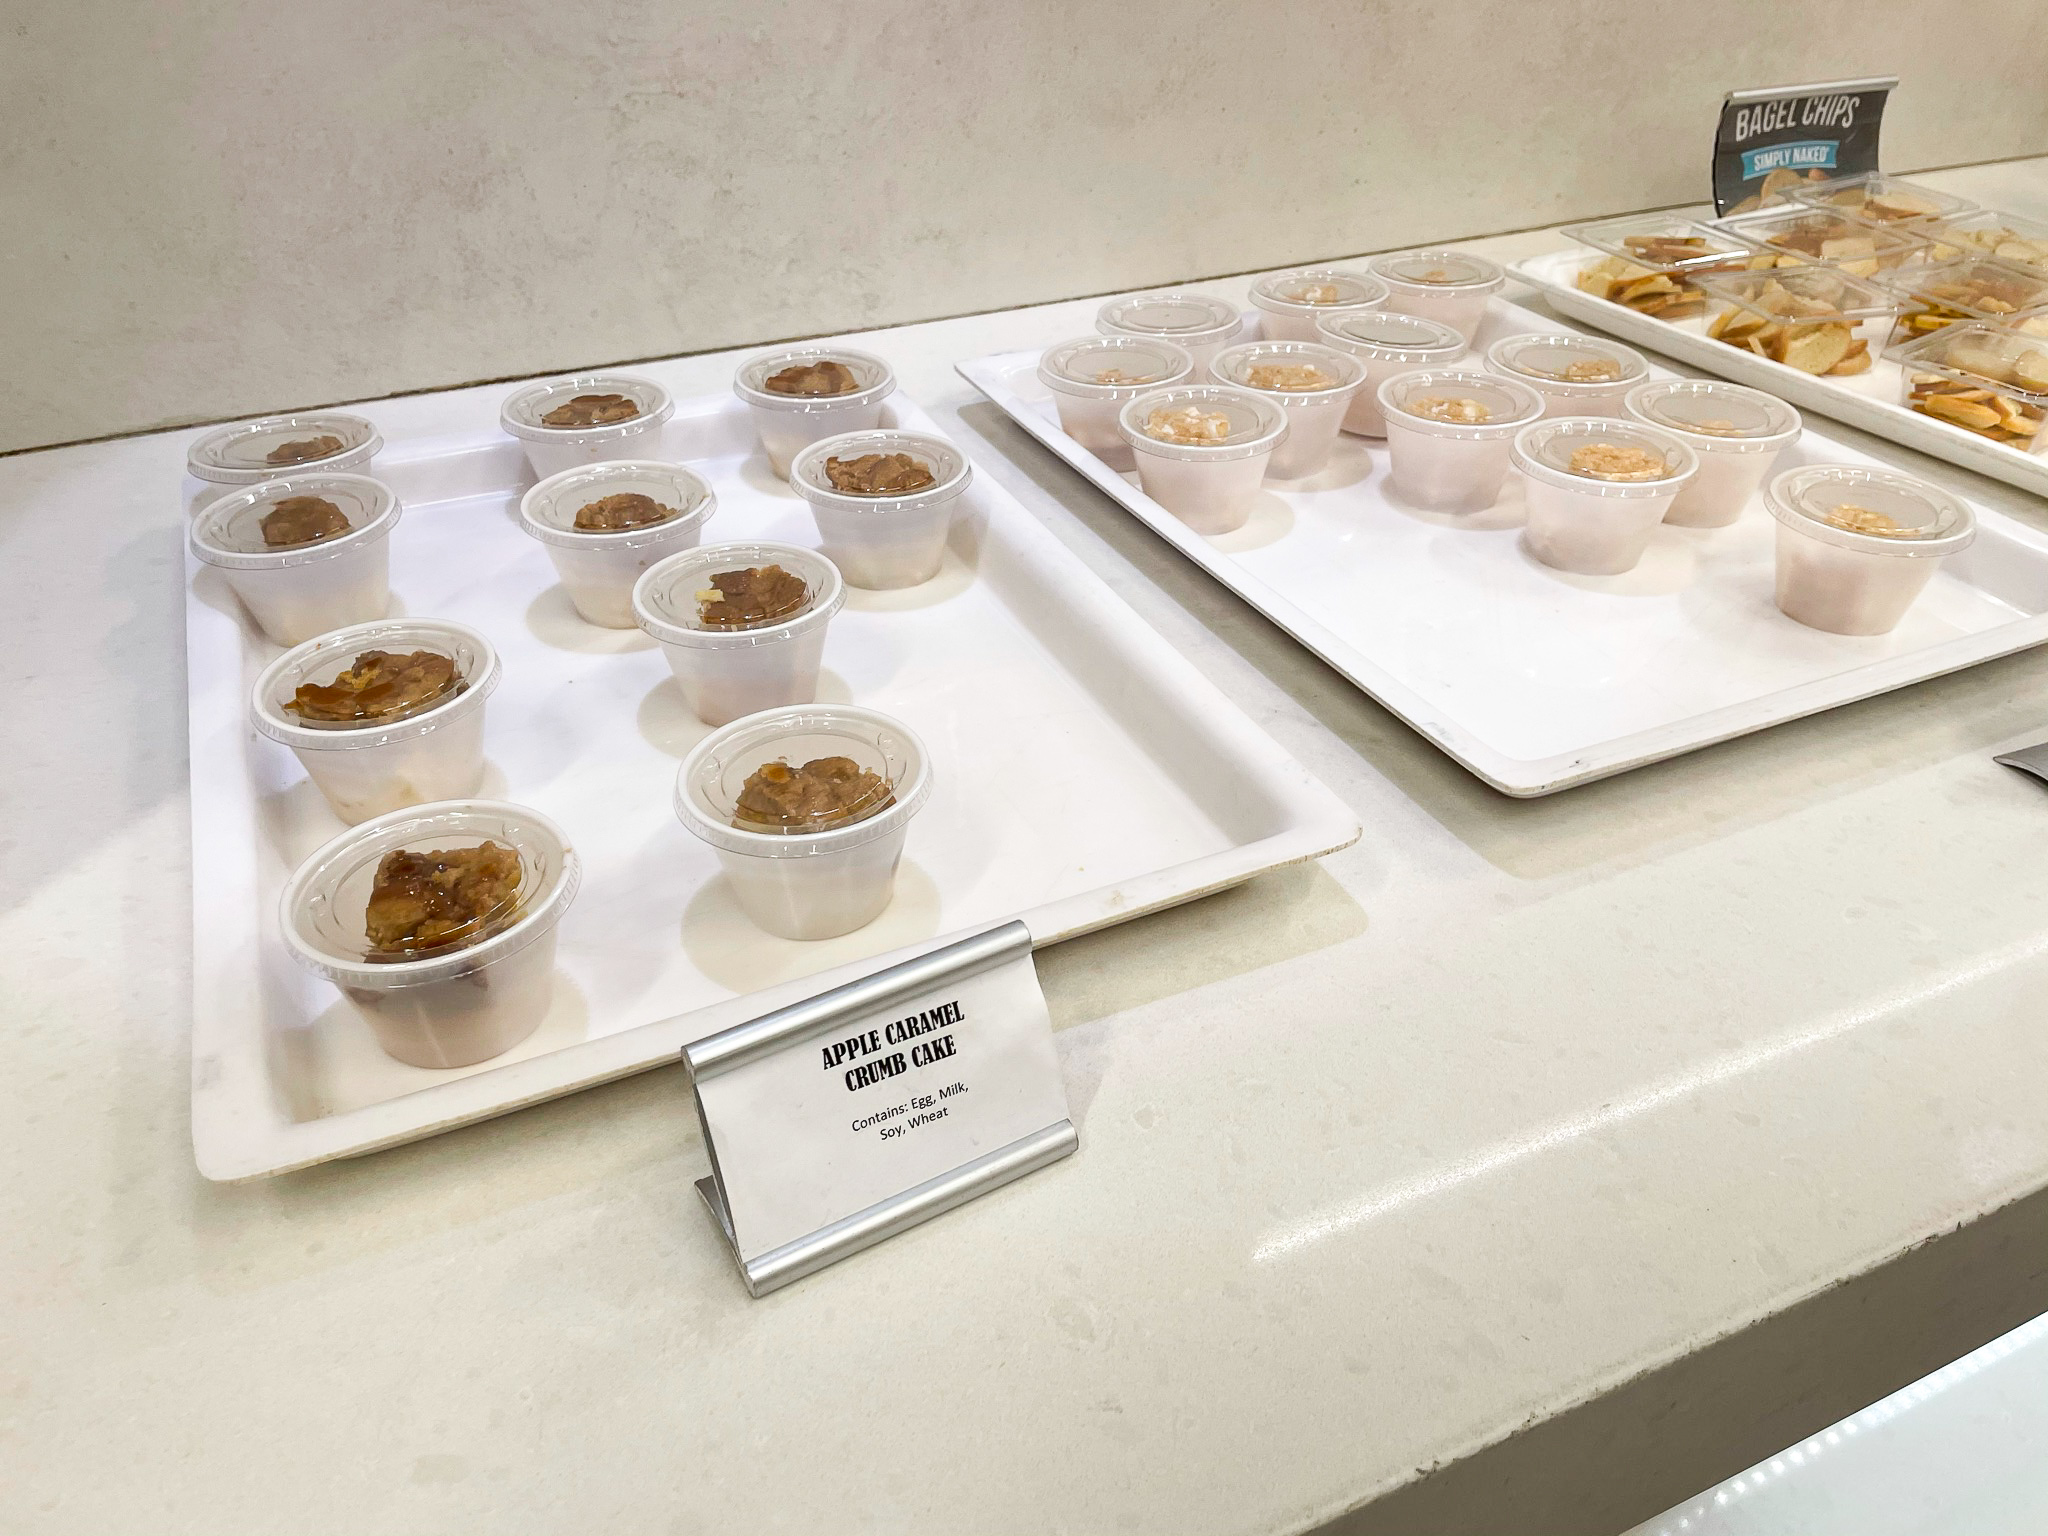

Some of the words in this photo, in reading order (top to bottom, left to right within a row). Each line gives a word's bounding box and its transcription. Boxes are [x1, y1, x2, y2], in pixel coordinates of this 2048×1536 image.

[1736, 99, 1798, 142] BAGEL
[1802, 95, 1860, 129] CHIPS
[1754, 149, 1791, 171] SIMPLY
[1793, 146, 1828, 163] NAKED
[822, 1030, 882, 1070] APPLE
[885, 1000, 965, 1045] CARAMEL
[845, 1052, 907, 1091] CRUMB
[911, 1034, 957, 1067] CAKE
[852, 1103, 909, 1131] Contains:
[911, 1094, 937, 1109] Egg,
[939, 1081, 969, 1100] Milk,
[880, 1125, 906, 1140] Soy,
[907, 1107, 948, 1129] Wheat
